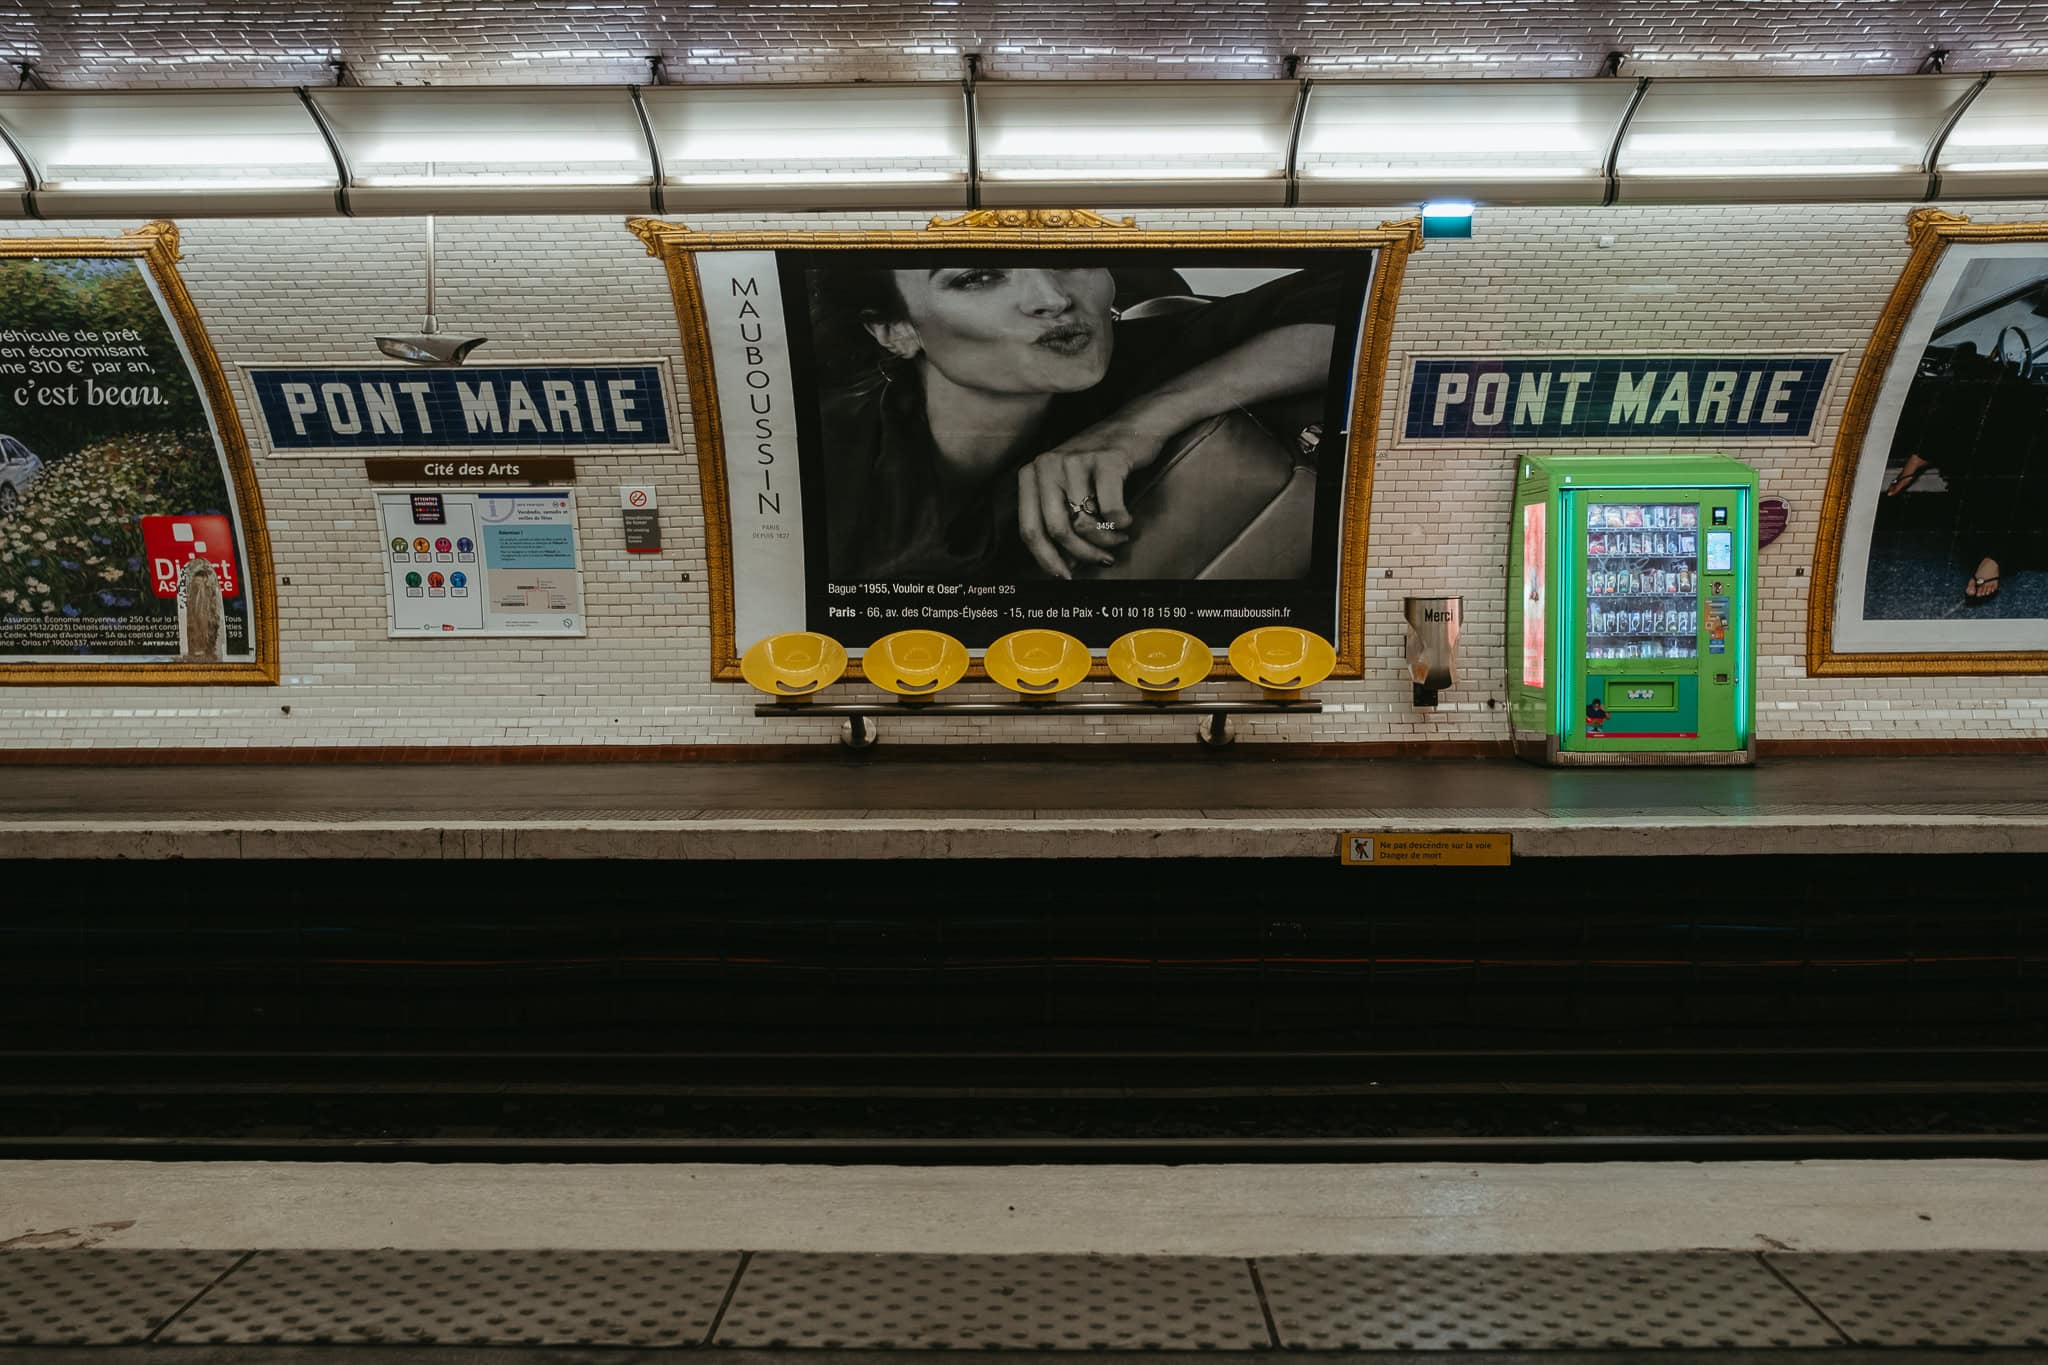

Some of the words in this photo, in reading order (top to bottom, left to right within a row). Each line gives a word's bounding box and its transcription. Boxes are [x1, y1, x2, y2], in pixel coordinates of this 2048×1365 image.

[74, 329, 99, 342] de
[102, 328, 142, 344] prêt
[1, 347, 25, 358] en
[29, 344, 149, 358] économisant
[29, 360, 62, 373] 310
[92, 362, 121, 375] par
[127, 361, 156, 374] an,
[14, 379, 79, 406] c'est
[83, 378, 169, 406] beau.
[732, 277, 780, 514] MAUBOUSSIN
[1432, 372, 1592, 426] PONT
[1608, 371, 1803, 424] MARIE
[281, 381, 433, 435] PONT
[457, 379, 643, 433] MARIE
[424, 463, 454, 476] Cité
[458, 463, 485, 476] des
[488, 463, 520, 476] Arts
[1096, 521, 1115, 530] 345€
[828, 583, 857, 596] Bague
[893, 583, 924, 594] Vouloir
[967, 585, 996, 596] Argent
[998, 585, 1016, 594] 925
[118, 615, 128, 623] de
[129, 615, 144, 623] 250
[829, 606, 857, 618] Paris
[867, 606, 883, 619] 66,
[885, 608, 899, 618] av.
[901, 606, 919, 618] des
[1028, 609, 1044, 618] rue
[1046, 607, 1059, 618] de
[1061, 607, 1070, 618] la
[1072, 606, 1093, 618] Paix
[1111, 607, 1123, 618] 01
[1142, 607, 1154, 618] 18
[1158, 607, 1171, 618] 15
[1173, 607, 1187, 618] 90
[1197, 607, 1291, 618] www.mauboussin.fr
[1424, 608, 1454, 622] Merci
[1380, 841, 1391, 849] Ne
[1393, 842, 1407, 851] pas
[1408, 841, 1449, 849] descendre
[1465, 841, 1473, 849] la
[1475, 841, 1492, 849] voie
[1380, 851, 1409, 860] Danger
[1410, 851, 1421, 859] de
